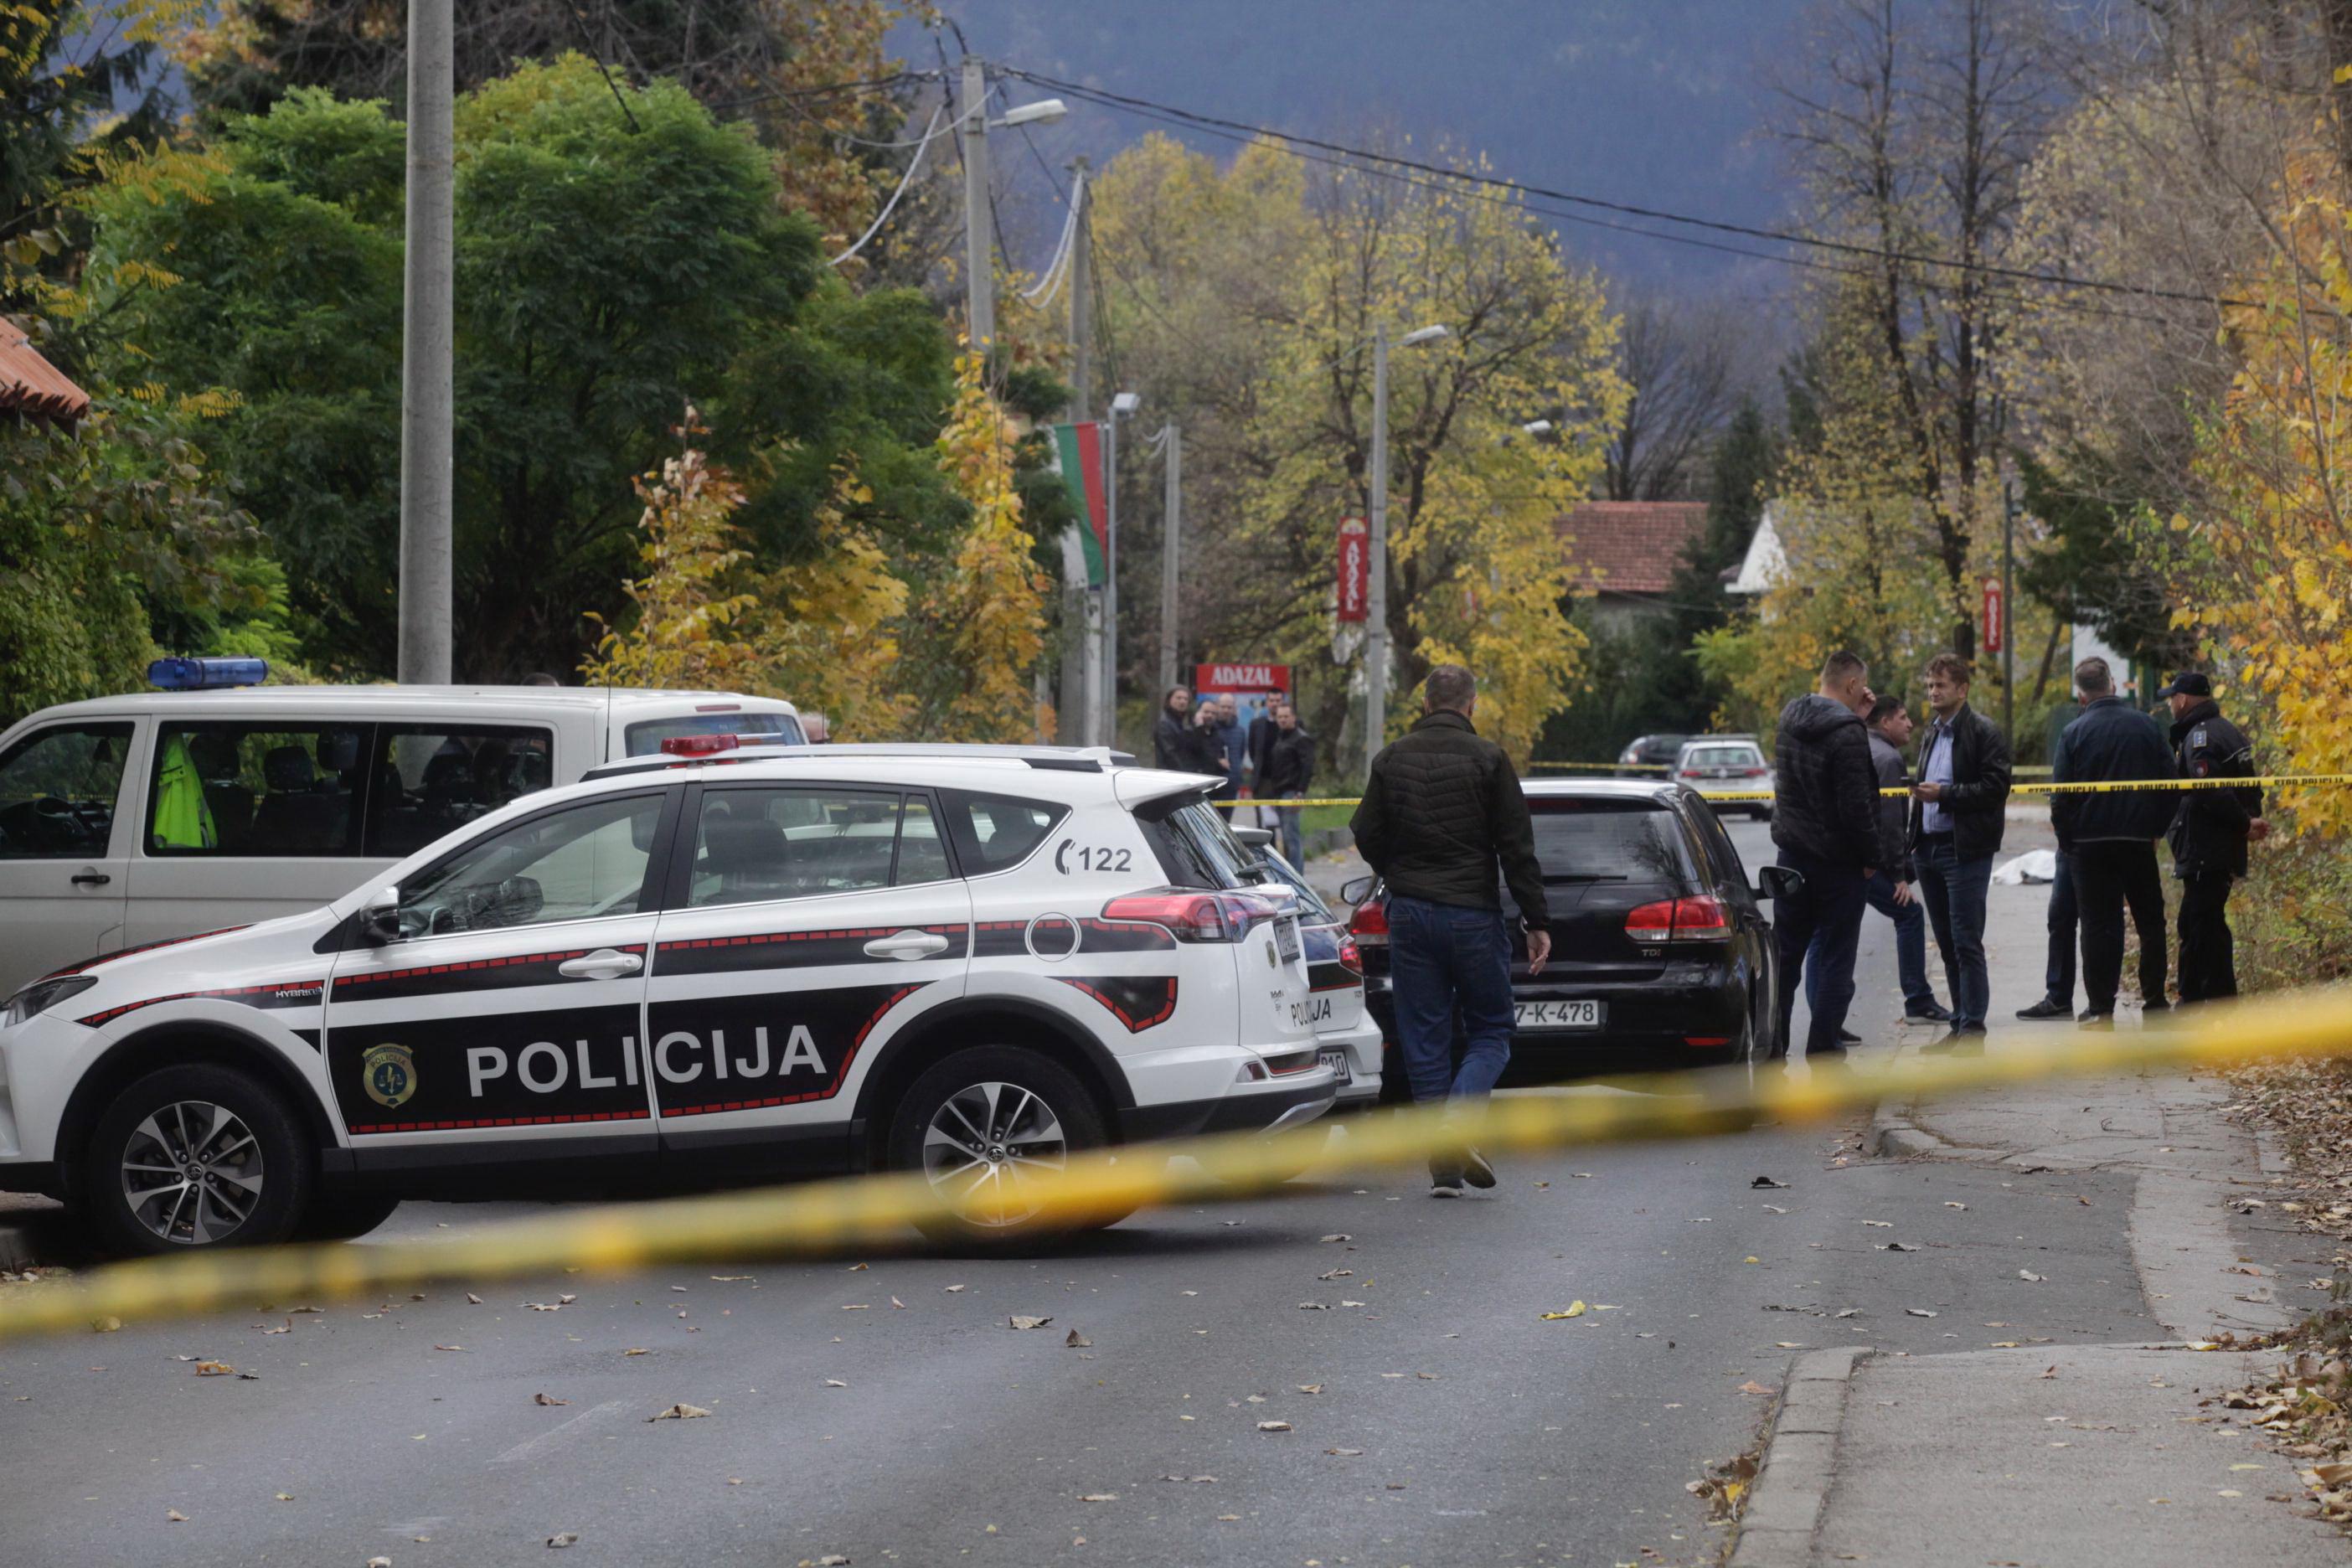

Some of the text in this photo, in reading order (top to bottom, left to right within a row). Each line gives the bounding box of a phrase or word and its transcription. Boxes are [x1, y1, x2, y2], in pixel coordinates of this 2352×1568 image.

[1210, 666, 1275, 686] ADAZAL
[1078, 846, 1132, 872] 122
[1514, 1003, 1595, 1024] 7-K-478
[467, 1024, 827, 1097] POLICIJA
